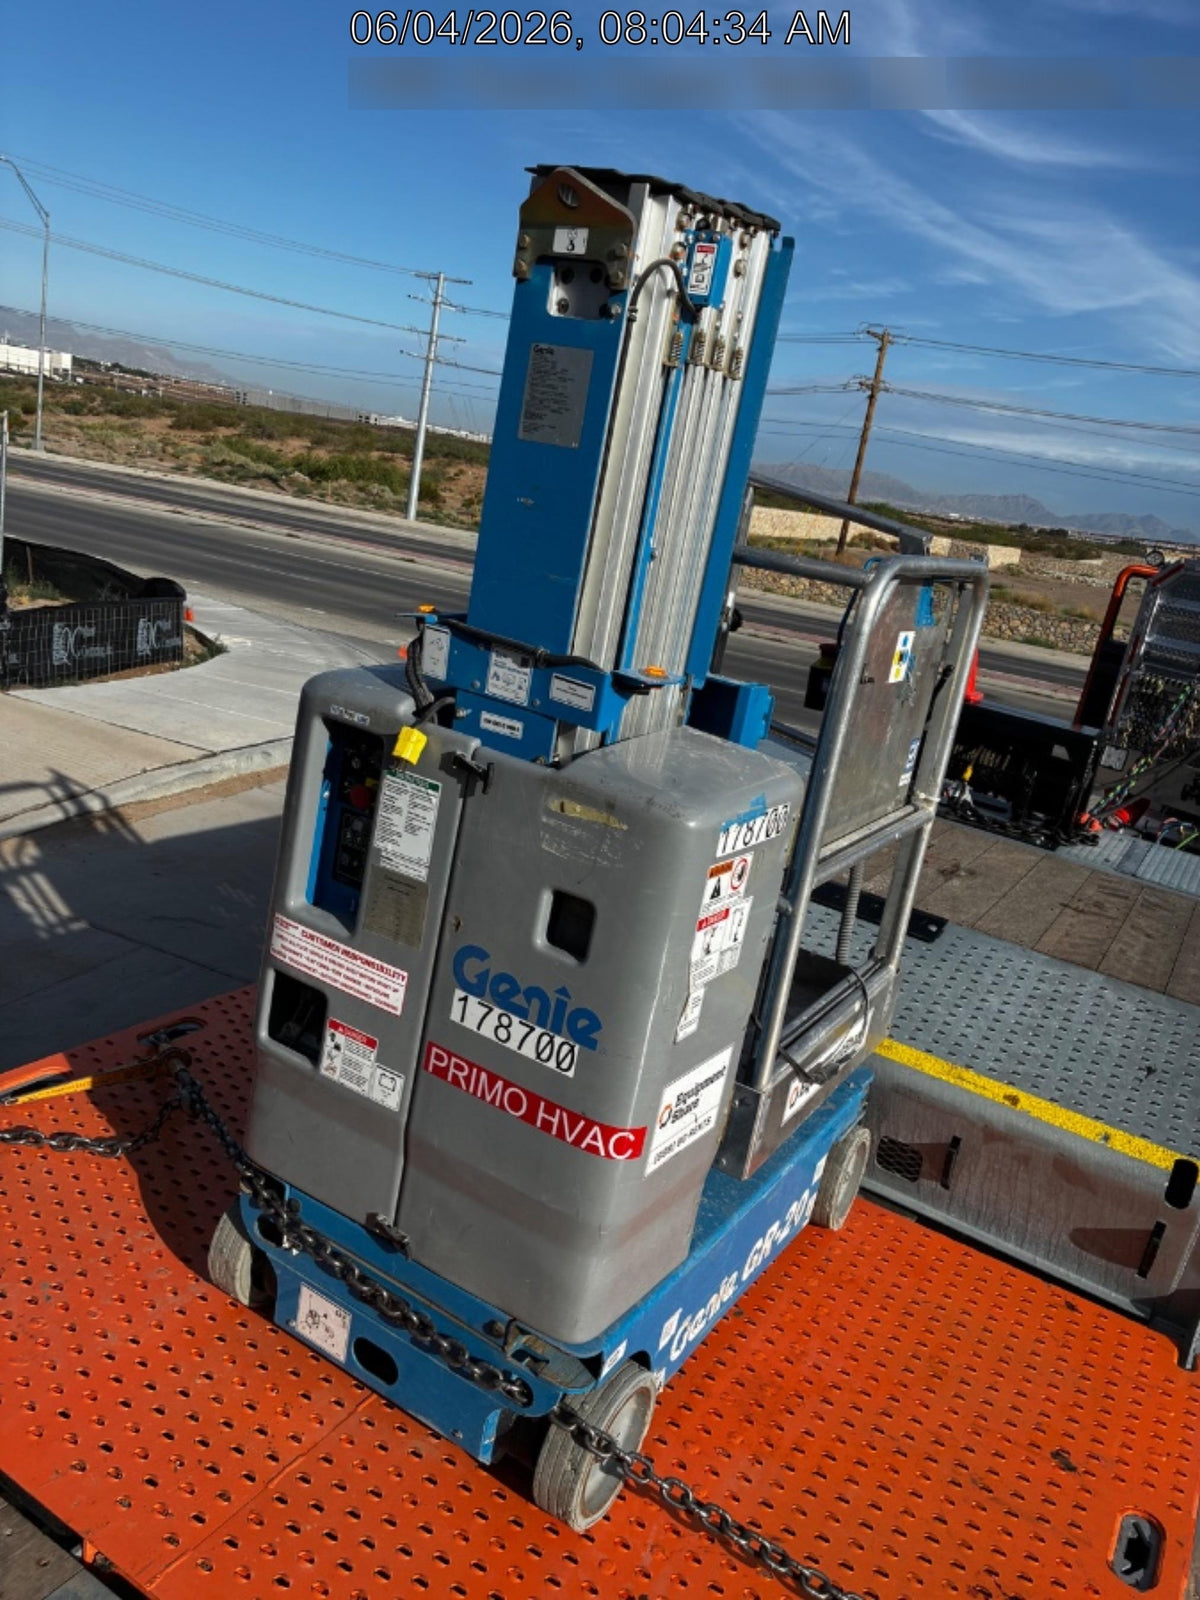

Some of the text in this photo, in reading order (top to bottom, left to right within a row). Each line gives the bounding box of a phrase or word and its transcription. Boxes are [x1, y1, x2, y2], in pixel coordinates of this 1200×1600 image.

[301, 929, 340, 953] CUSTOMER
[341, 947, 406, 982] RESPONSIBILITY
[453, 944, 603, 1051] Genie
[457, 994, 577, 1073] 178700
[428, 1046, 528, 1117] PRIMO
[536, 1101, 635, 1159] HVAC
[670, 1271, 739, 1361] Genie
